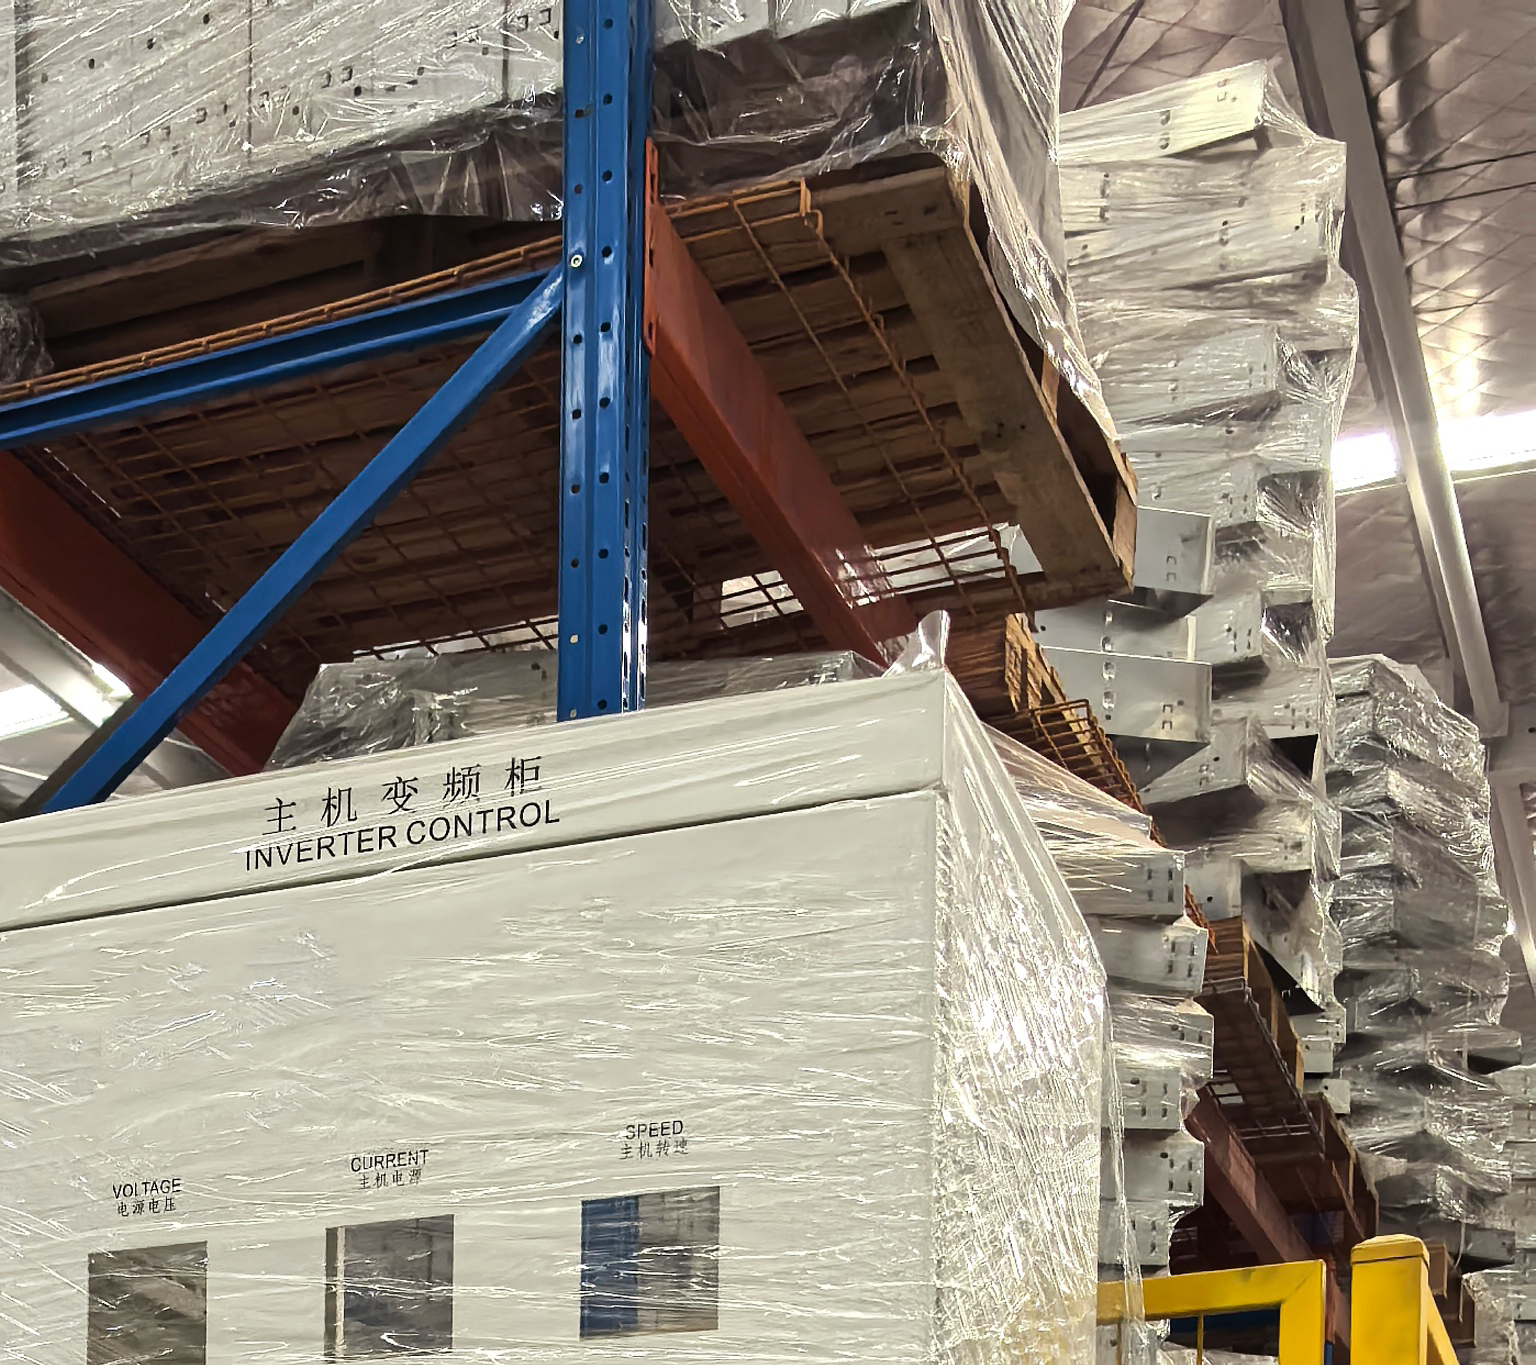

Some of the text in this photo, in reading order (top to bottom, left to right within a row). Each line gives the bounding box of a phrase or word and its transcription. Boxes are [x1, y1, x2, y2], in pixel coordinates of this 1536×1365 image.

[262, 756, 543, 836] 主机变频柜
[245, 800, 561, 872] INVERTER CONTROL
[625, 1120, 683, 1139] SPEED
[619, 1136, 689, 1160] 主机转速
[350, 1149, 429, 1173] CURRENT
[112, 1178, 182, 1199] VOLTAGE
[116, 1197, 177, 1217] 电源电压
